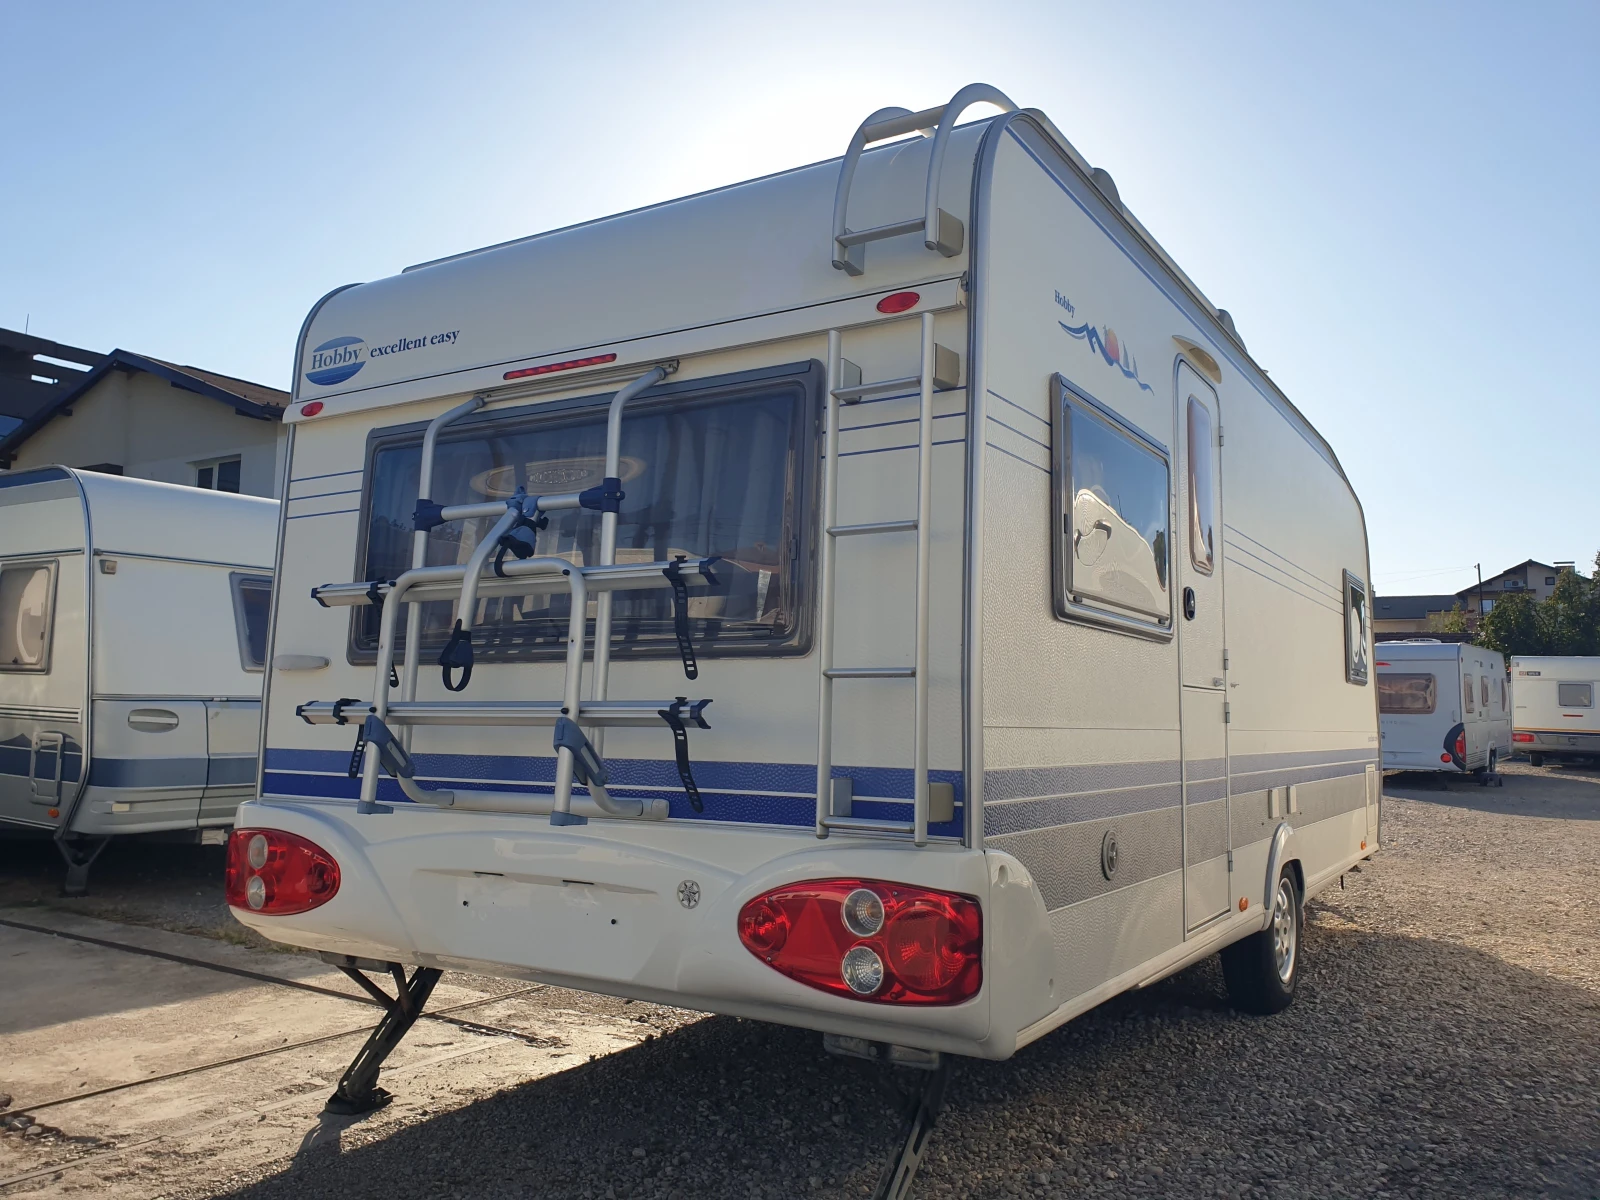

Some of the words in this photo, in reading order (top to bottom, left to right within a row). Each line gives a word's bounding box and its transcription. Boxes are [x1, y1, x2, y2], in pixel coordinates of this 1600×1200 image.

[1054, 289, 1076, 319] Hobby
[370, 335, 428, 358] excellent
[430, 329, 461, 345] easy
[311, 346, 363, 371] Hobby
